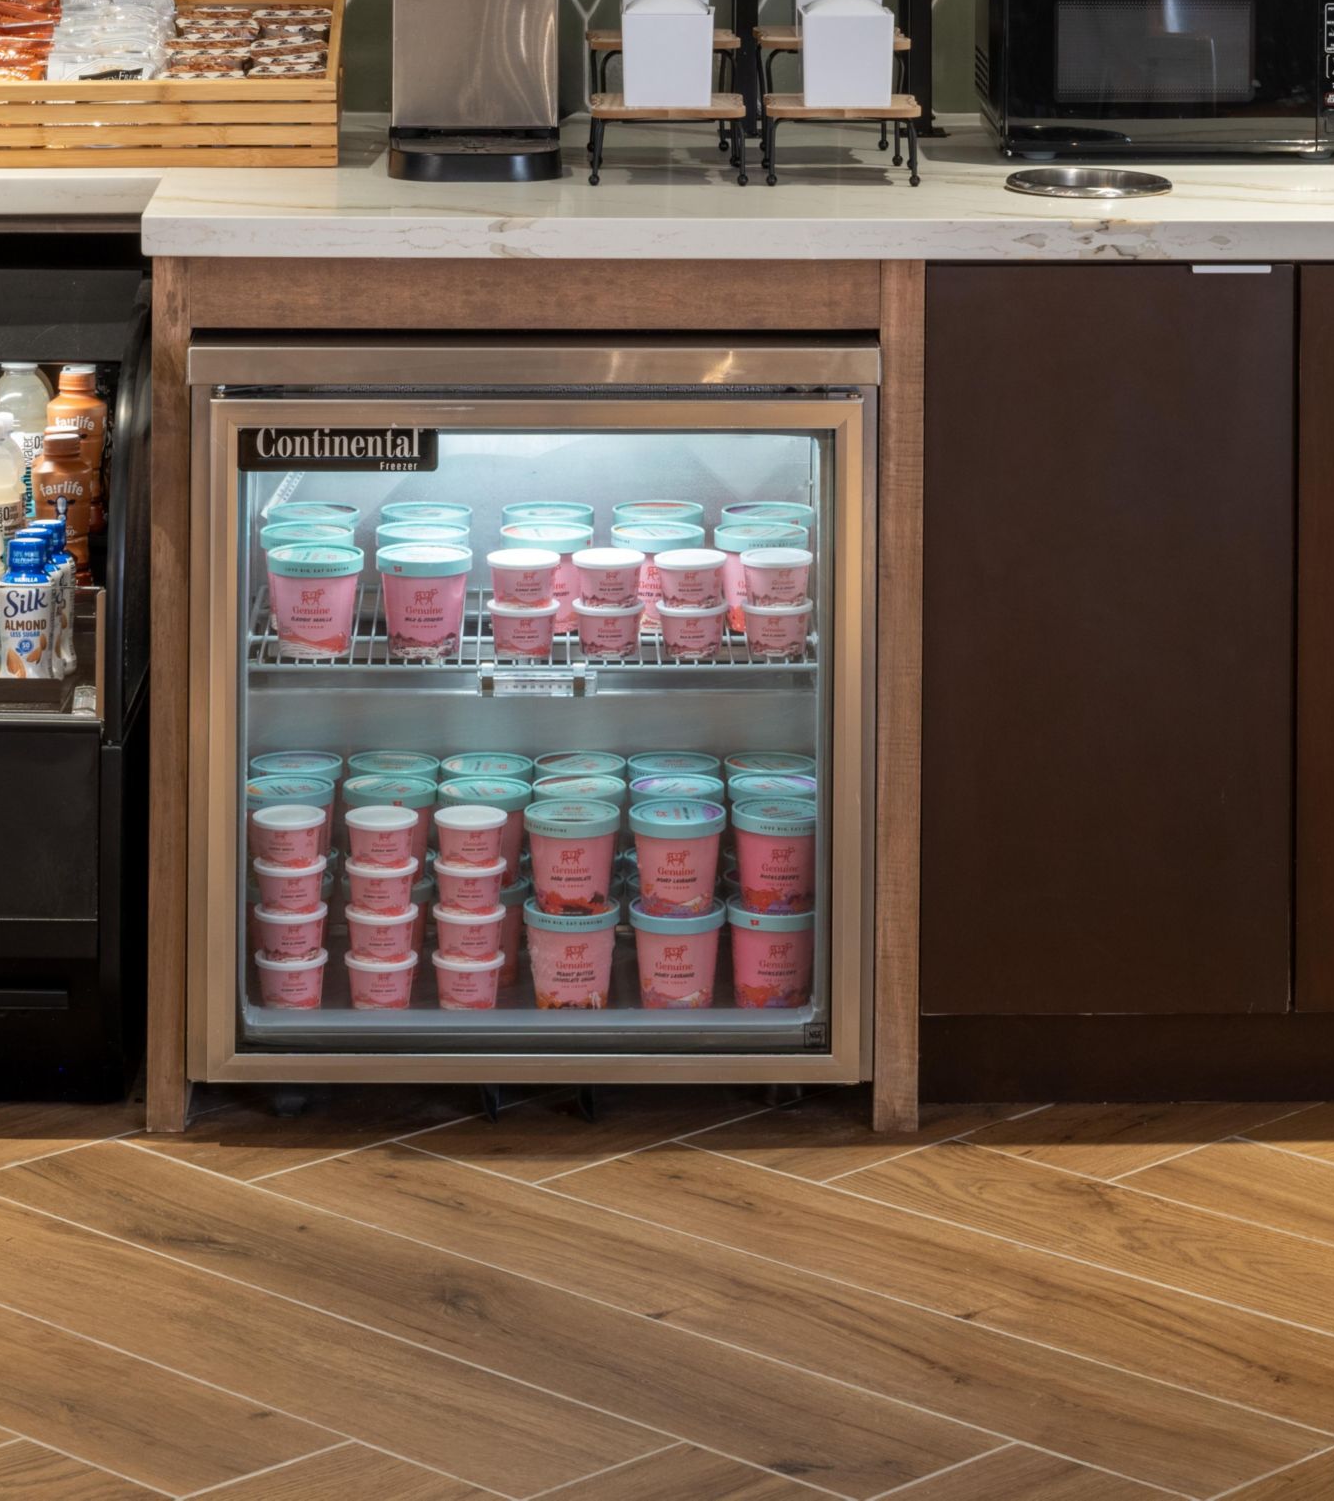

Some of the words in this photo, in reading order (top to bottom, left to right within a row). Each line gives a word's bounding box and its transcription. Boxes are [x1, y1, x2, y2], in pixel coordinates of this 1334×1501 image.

[256, 428, 420, 458] Continental
[380, 461, 418, 471] Freezer
[4, 588, 48, 618] Silk
[292, 606, 331, 615] Genuine
[405, 606, 443, 615] Genuine
[5, 620, 47, 631] ALMOND
[552, 866, 589, 874] Genuine
[658, 867, 695, 876] Genuine
[762, 863, 799, 872] Genuine
[556, 961, 593, 970] Genuine
[655, 962, 693, 971] Genuine
[759, 959, 797, 968] Genuine
